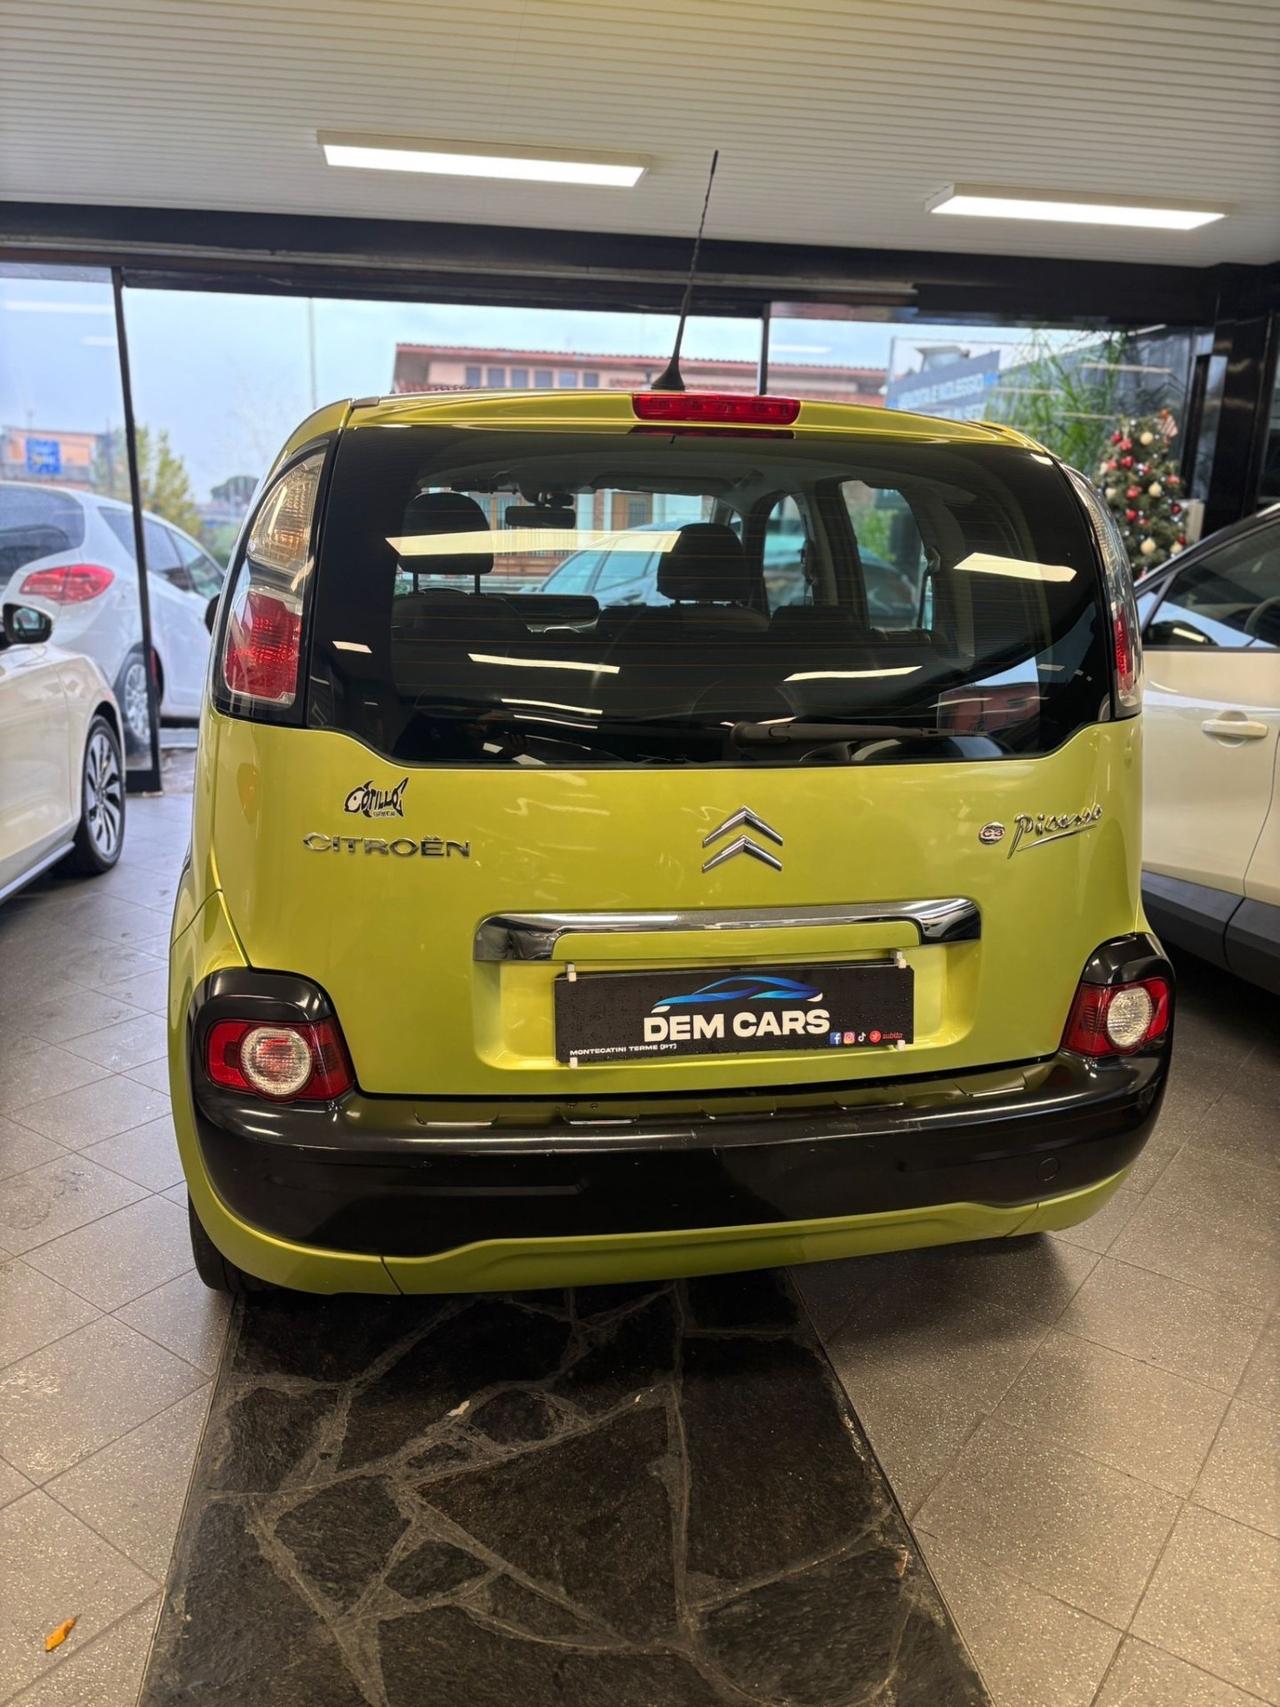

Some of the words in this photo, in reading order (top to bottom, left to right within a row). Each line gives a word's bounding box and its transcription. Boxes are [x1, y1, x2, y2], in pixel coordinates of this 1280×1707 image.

[982, 827, 1004, 838] C3
[303, 832, 471, 857] CITROËN
[644, 1012, 725, 1042] DEM
[733, 1009, 830, 1038] CARS
[569, 1046, 627, 1056] MONTECATINI
[628, 1044, 659, 1052] TERME
